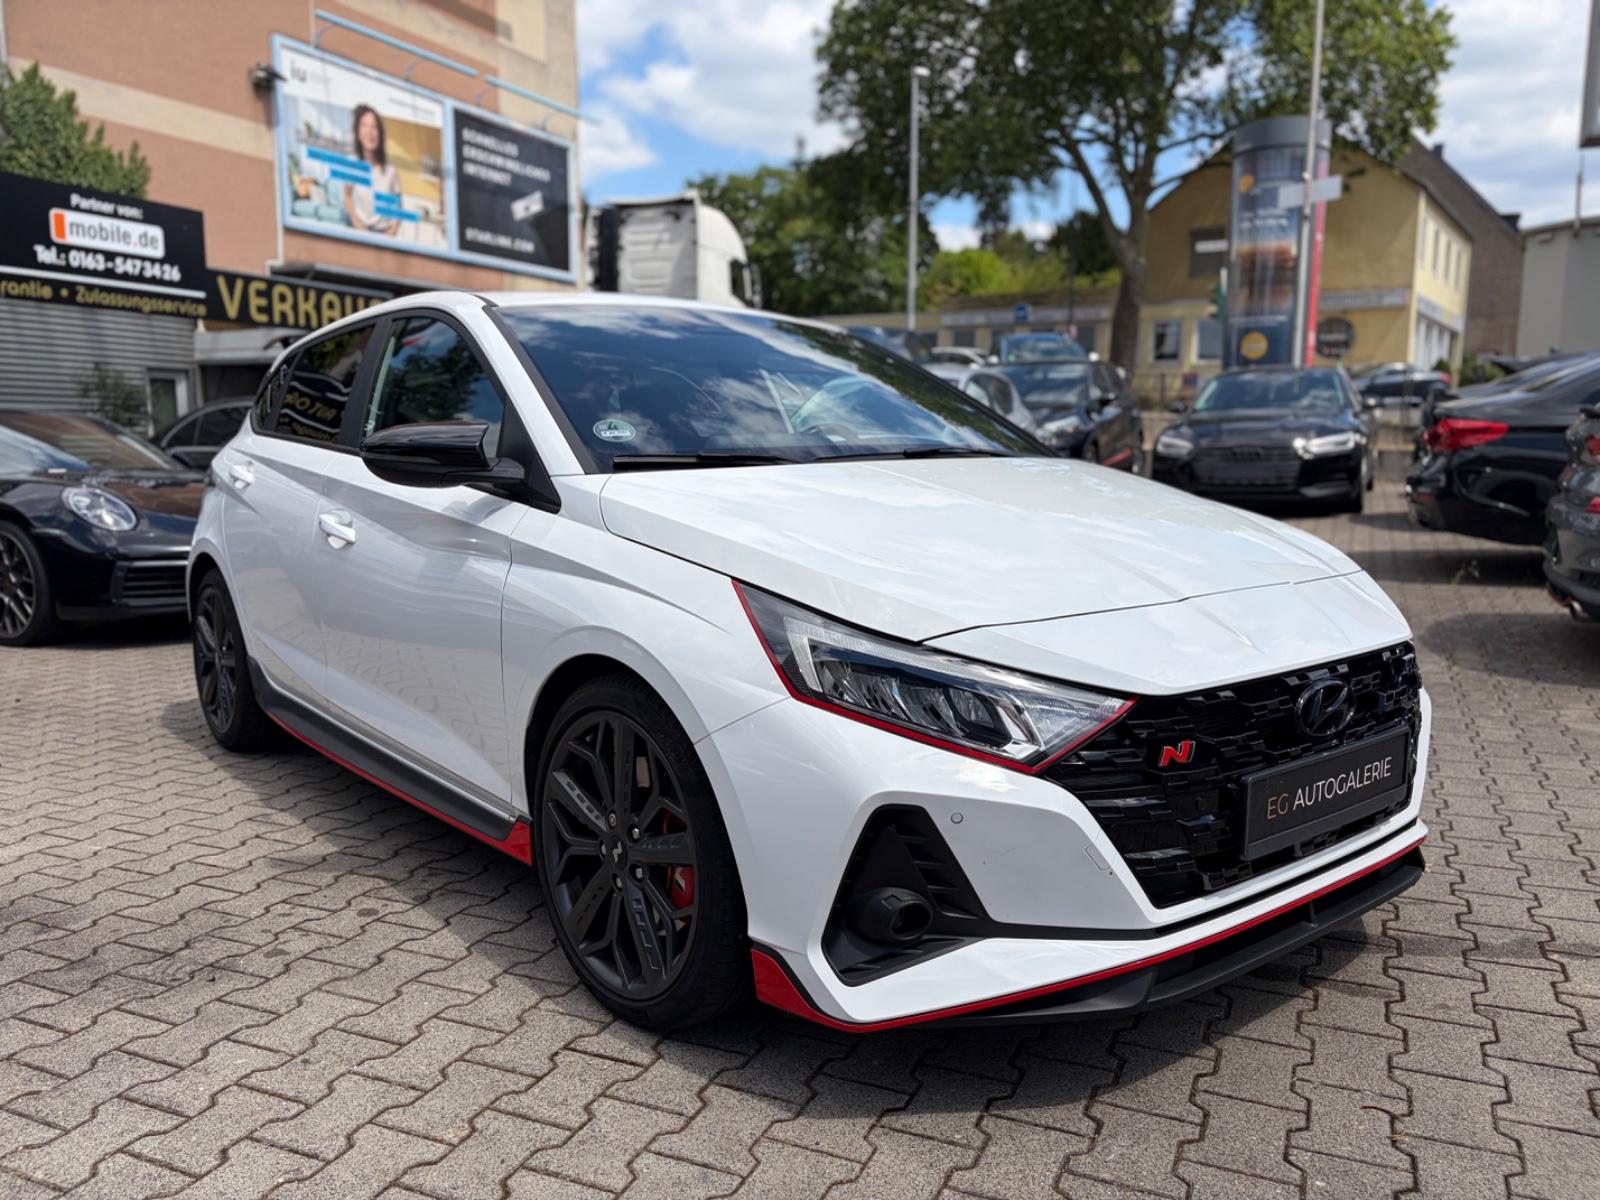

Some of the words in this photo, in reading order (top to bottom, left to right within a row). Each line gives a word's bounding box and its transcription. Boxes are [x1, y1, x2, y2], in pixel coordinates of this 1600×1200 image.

[70, 193, 117, 215] Partner
[69, 221, 160, 251] mobile.de
[33, 244, 67, 267] Tel.:
[216, 274, 384, 330] VERKA
[1266, 793, 1289, 821] EG
[1293, 756, 1392, 811] AUTOGALERIE
